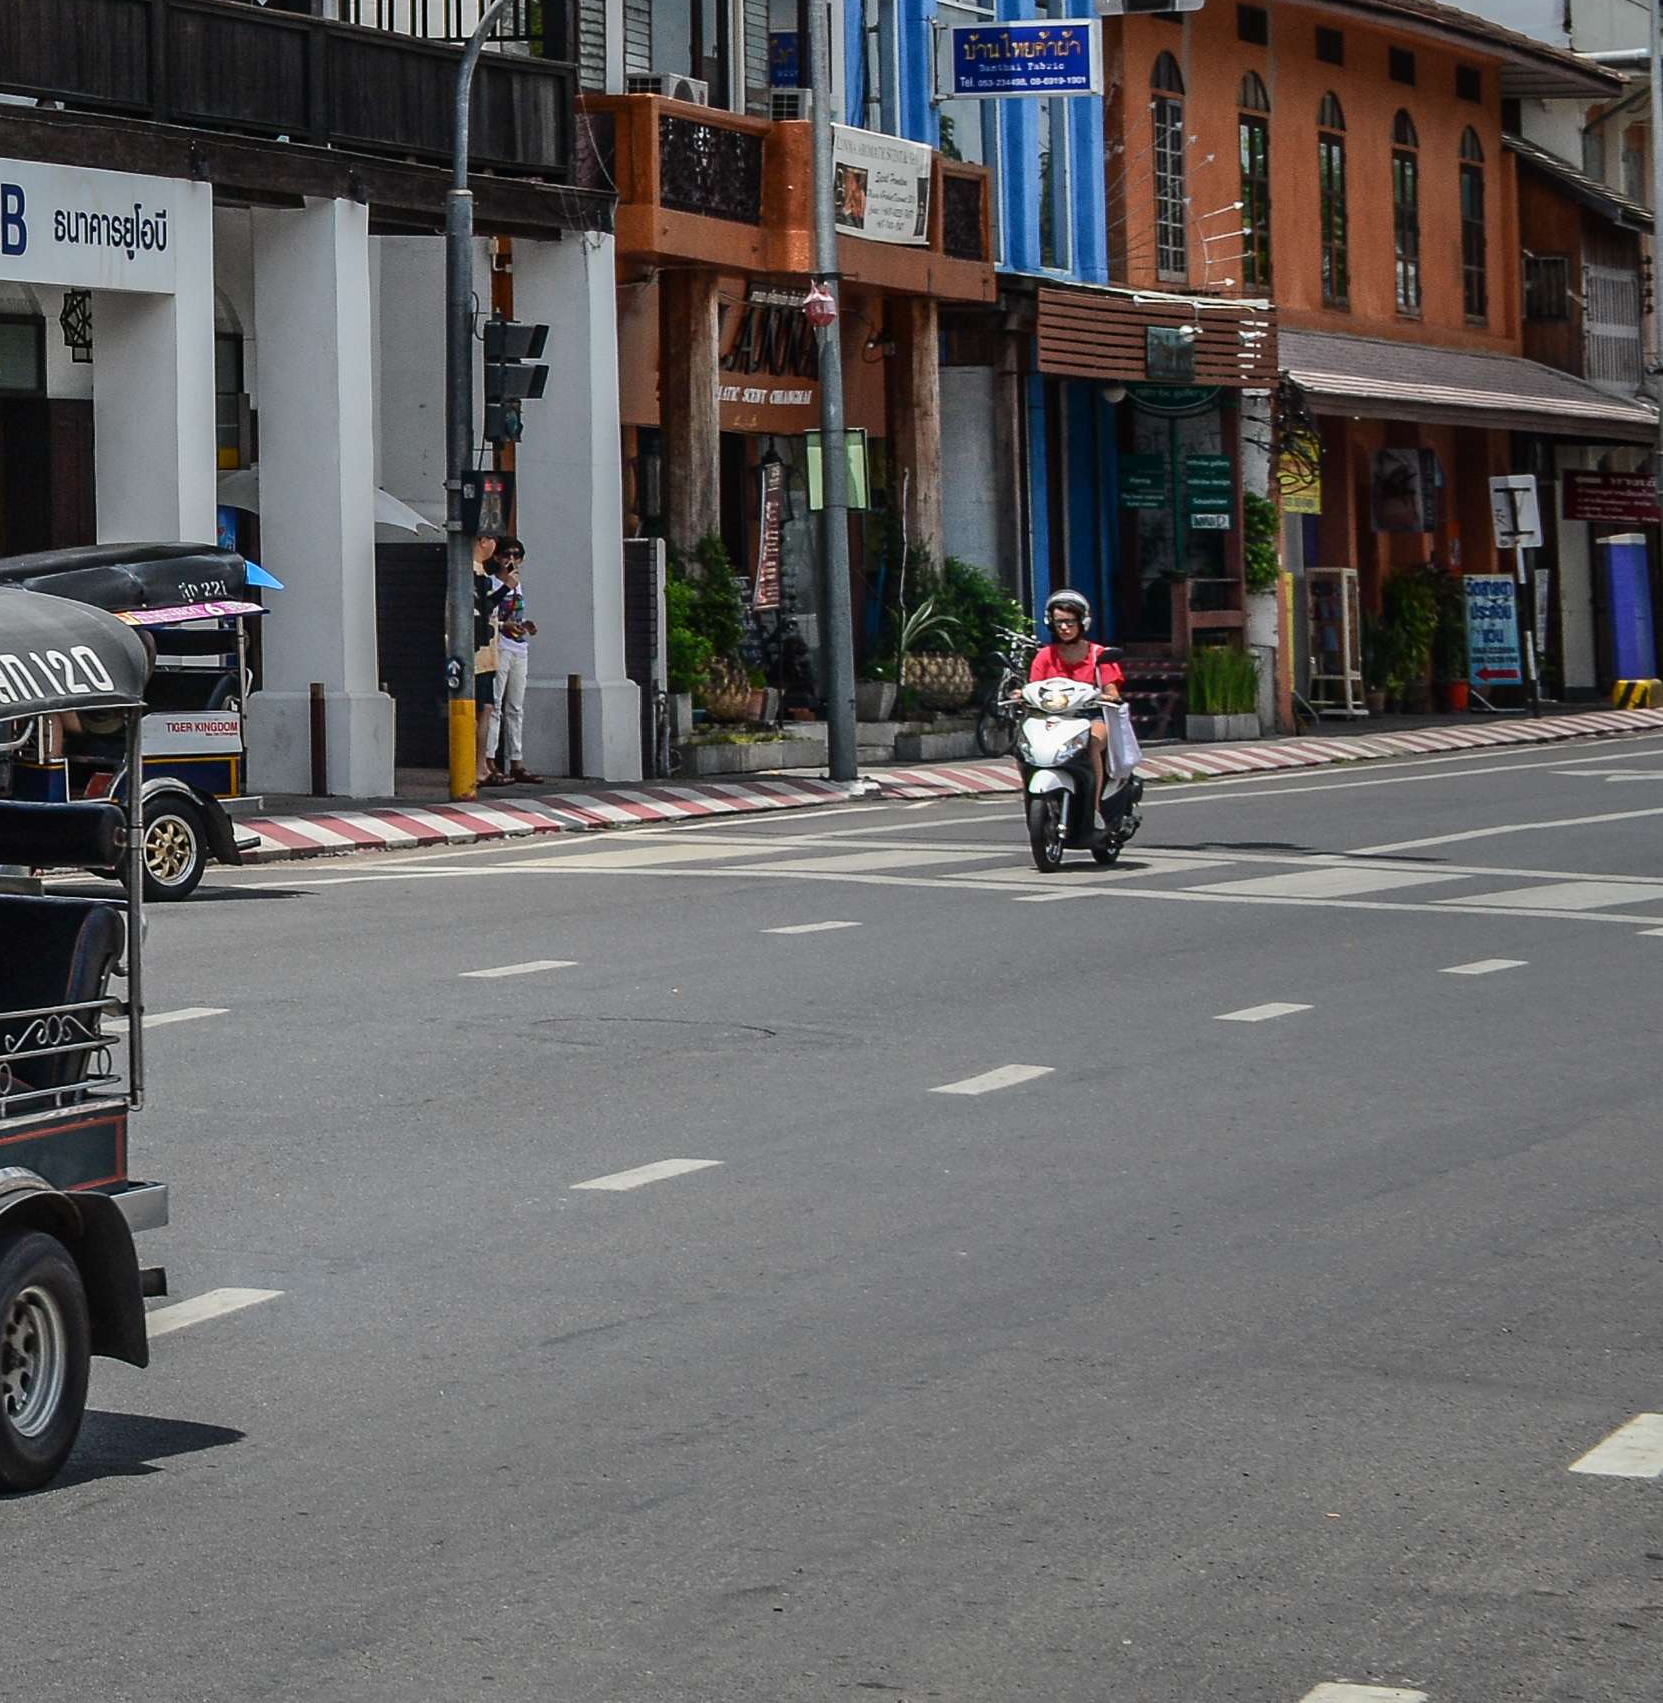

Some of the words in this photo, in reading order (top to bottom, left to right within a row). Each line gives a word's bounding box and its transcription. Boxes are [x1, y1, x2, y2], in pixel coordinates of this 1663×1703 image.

[1027, 62, 1066, 71] Fabric
[53, 202, 168, 261] ธนาคารยูโอบี
[30, 645, 115, 697] 120
[167, 722, 193, 733] TIGER
[195, 721, 238, 732] KINGDOM
